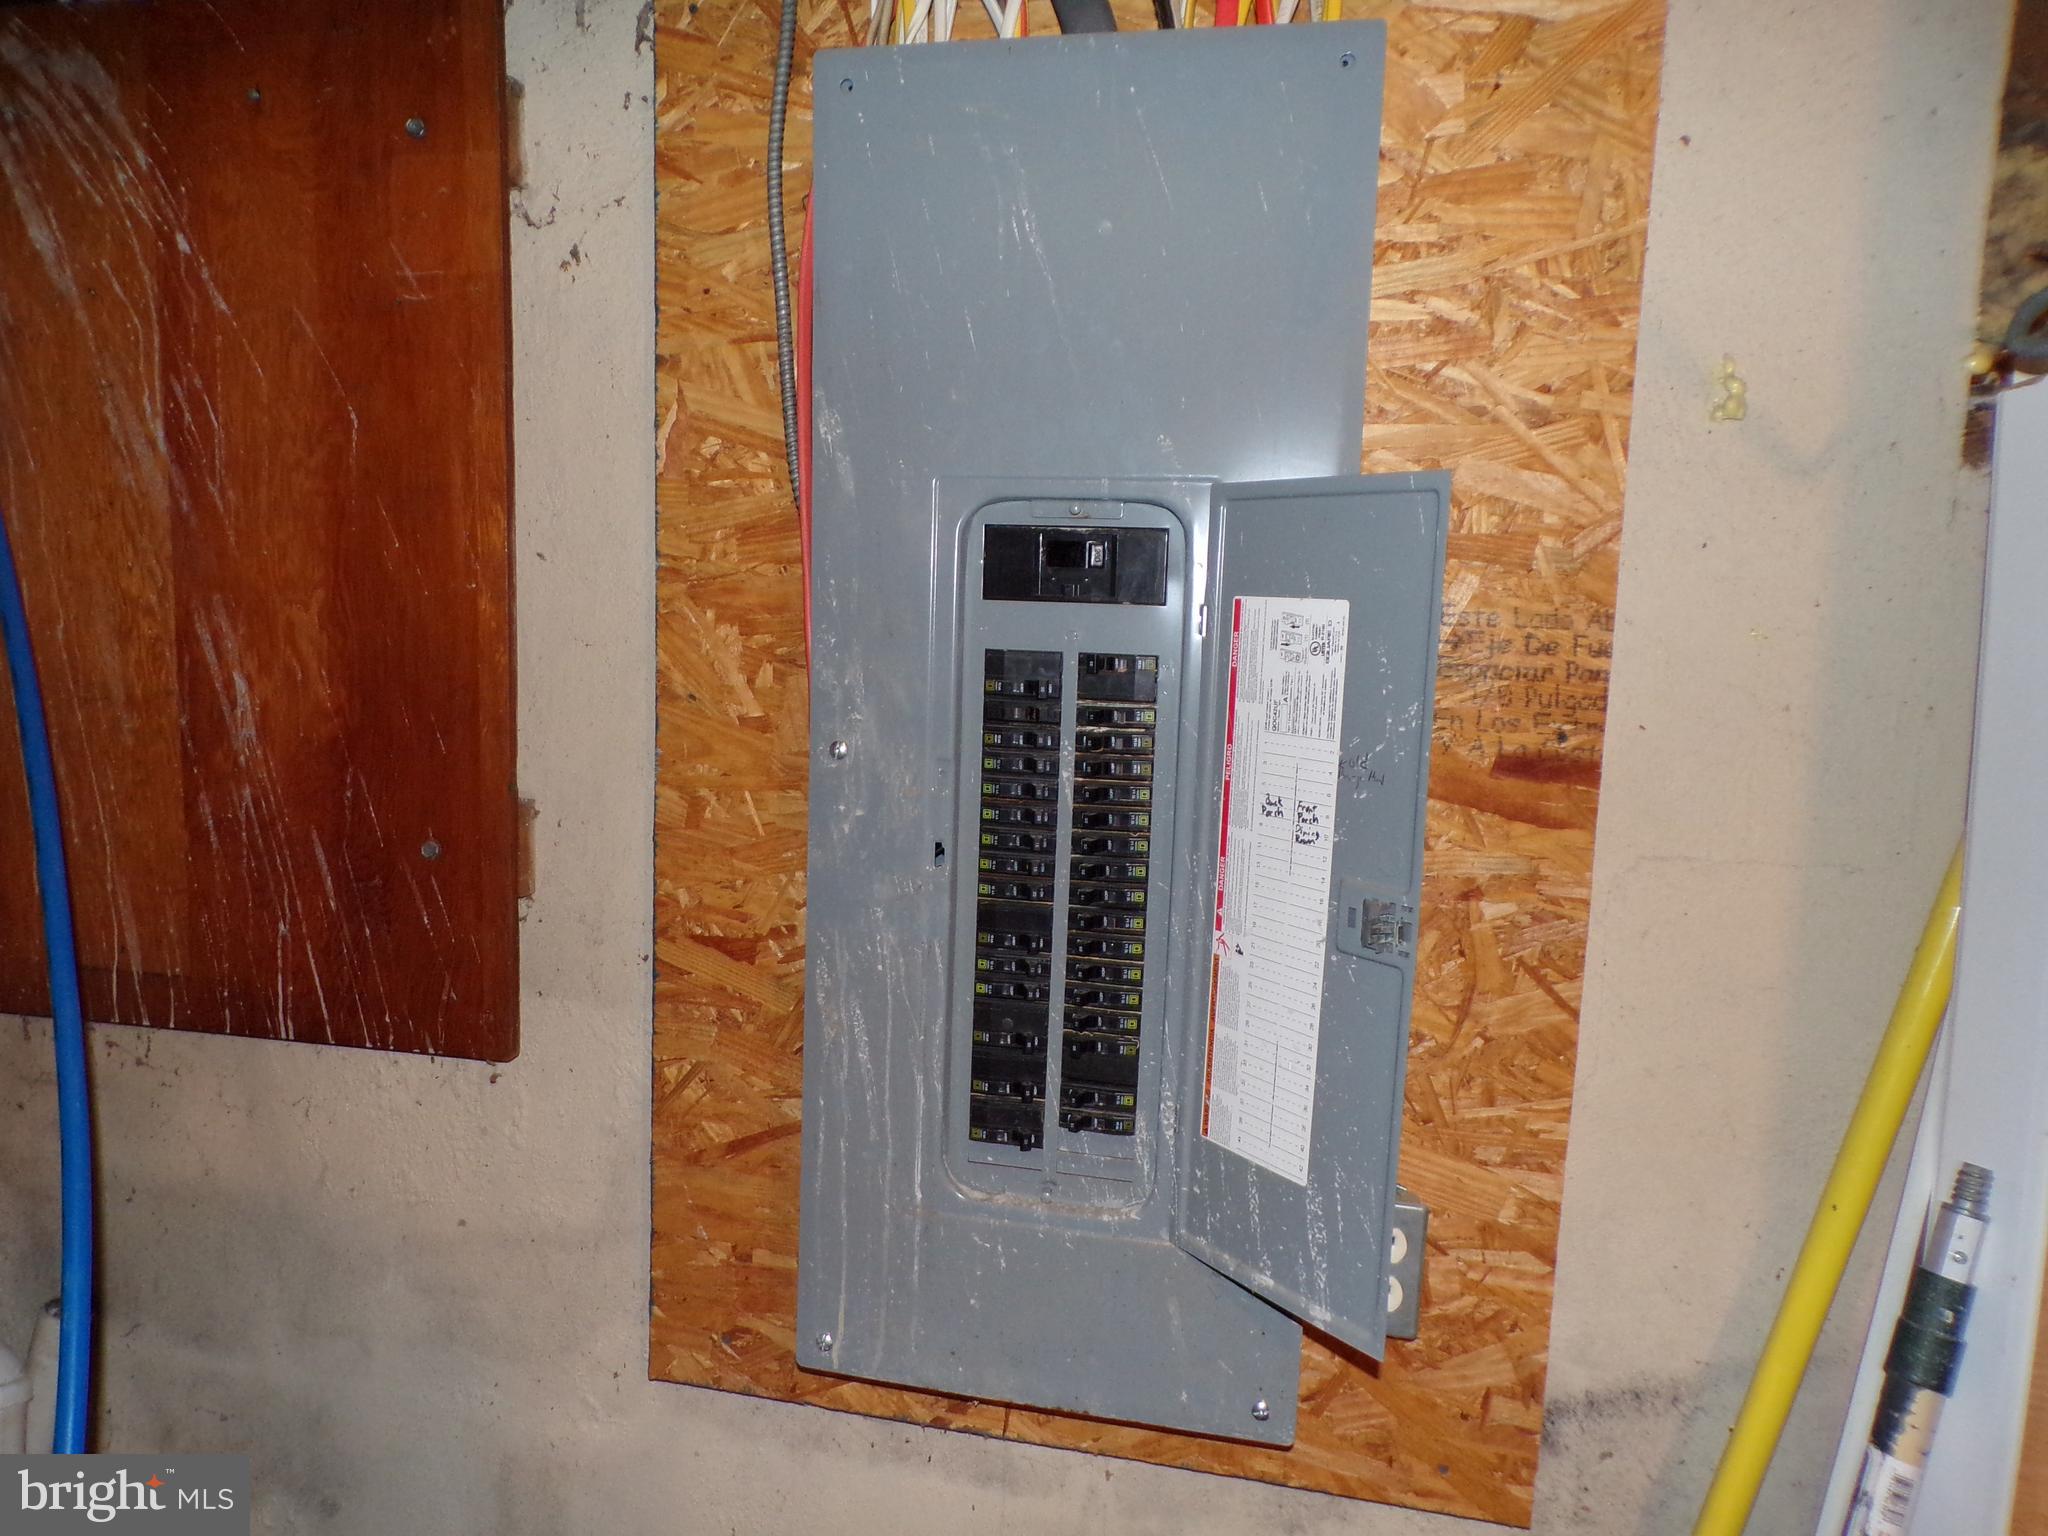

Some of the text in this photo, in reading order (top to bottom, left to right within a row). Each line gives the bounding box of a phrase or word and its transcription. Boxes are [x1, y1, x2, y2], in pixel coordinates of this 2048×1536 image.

[1231, 631, 1239, 667] DANGER
[1524, 632, 1560, 656] De
[1225, 743, 1233, 780] PELIGRO
[1218, 856, 1226, 891] DANGER
